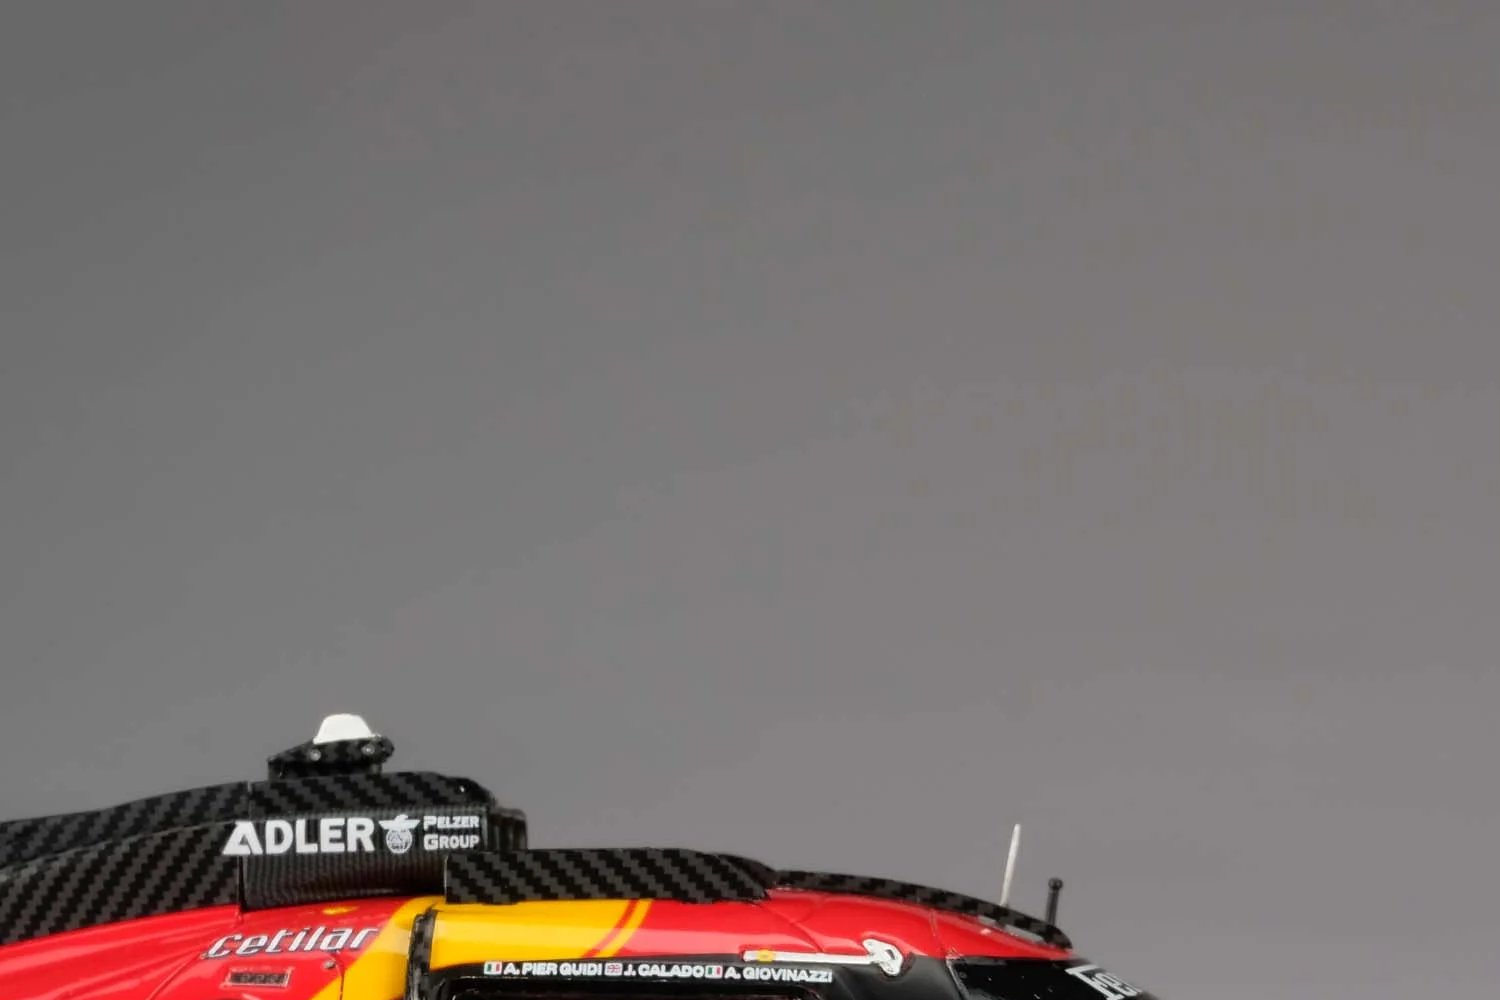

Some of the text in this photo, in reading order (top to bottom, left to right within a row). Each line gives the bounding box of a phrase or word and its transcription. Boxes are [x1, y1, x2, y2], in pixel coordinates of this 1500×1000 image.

[423, 815, 480, 829] PELZER
[222, 817, 376, 855] ADLER
[423, 834, 480, 850] GROUP
[522, 962, 558, 976] PIER
[559, 963, 602, 976] GUIDI
[638, 964, 705, 979] CALADO
[742, 967, 833, 983] GIOVINAZZI
